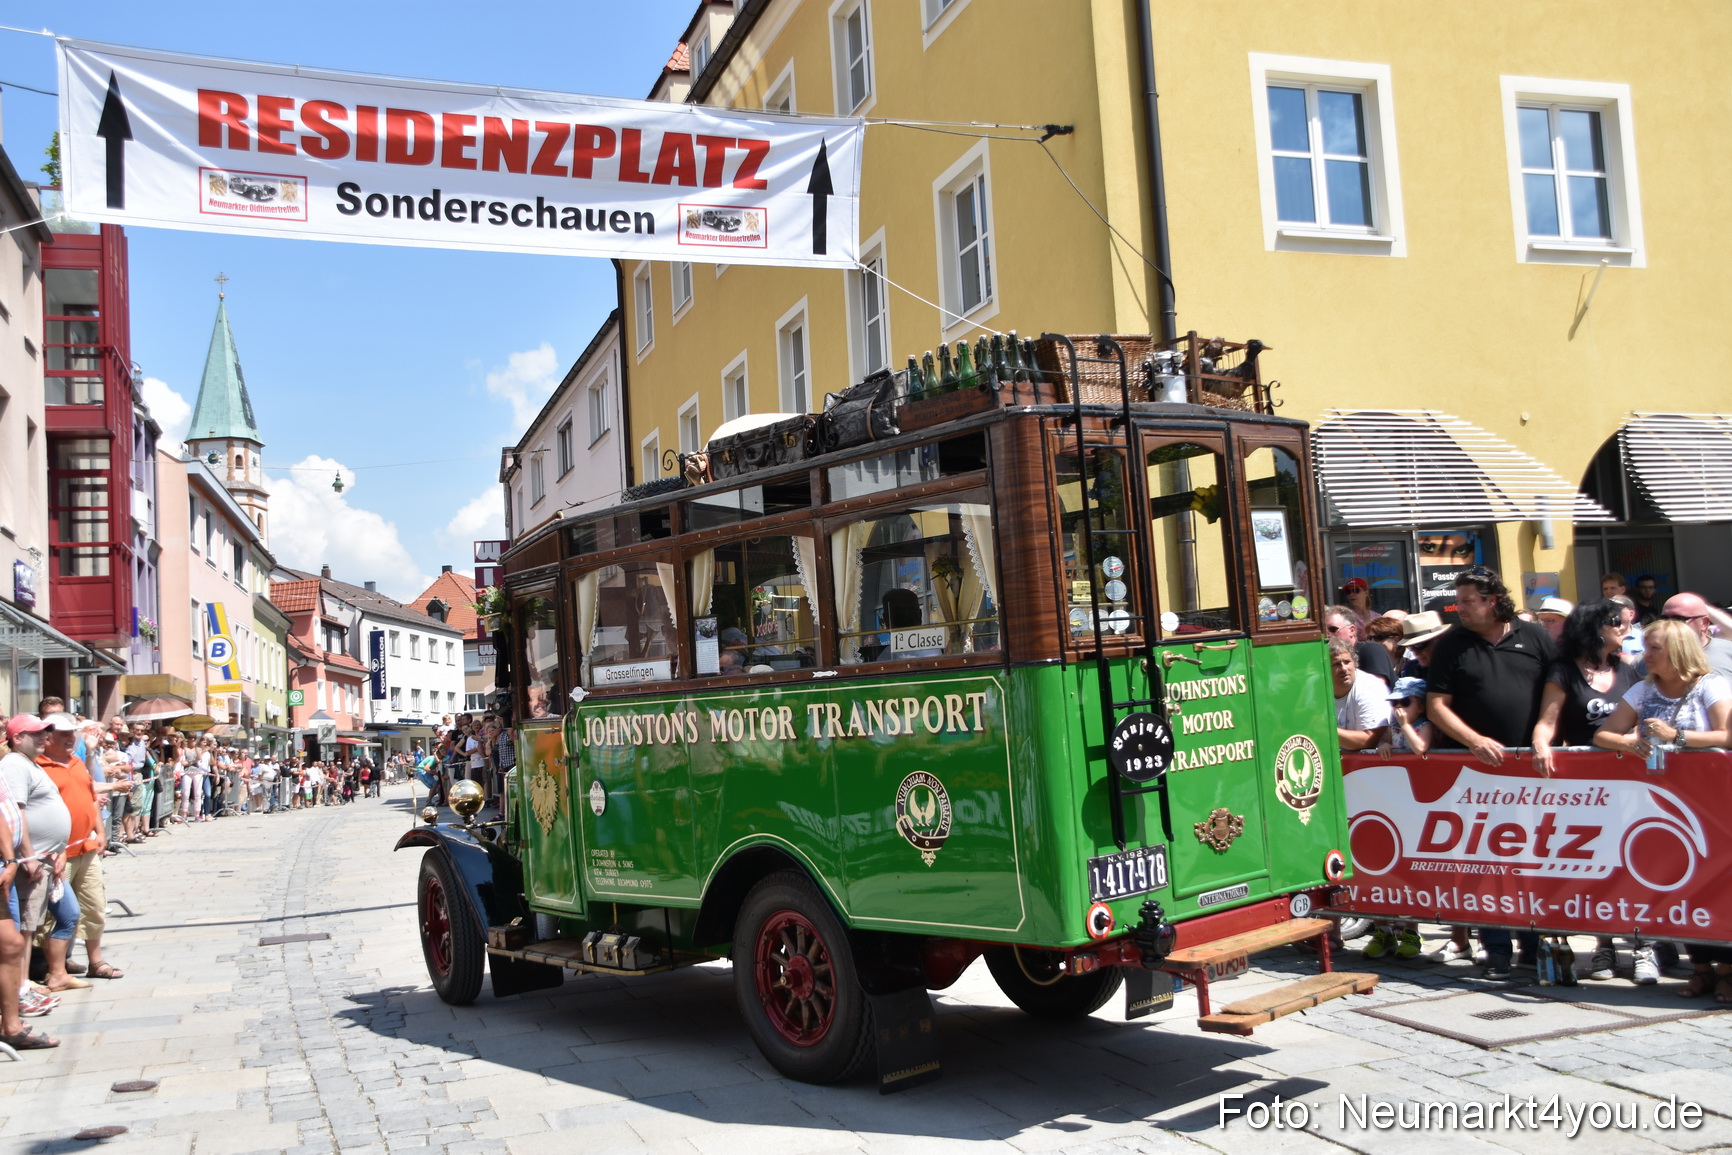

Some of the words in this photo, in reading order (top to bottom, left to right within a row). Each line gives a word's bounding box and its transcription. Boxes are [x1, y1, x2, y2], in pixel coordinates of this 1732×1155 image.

[198, 88, 770, 190] RESIDENZPLATZ
[209, 198, 248, 212] Neumarkter
[249, 204, 301, 214] Oldtimertreffen
[336, 181, 655, 235] Sonderschauen
[685, 230, 718, 242] Neumarkter
[718, 234, 761, 243] Oldtimertreffen
[1422, 588, 1457, 597] Bewerbun
[908, 632, 943, 649] Classe
[606, 666, 655, 681] Grosselfingen
[1162, 674, 1247, 704] JOHNSTON'S
[583, 709, 699, 747] JOHNSTON'S
[709, 705, 797, 742] MOTOR
[806, 692, 987, 739] TRANSPORT
[1182, 709, 1235, 735] MOTOR
[1113, 718, 1170, 751] Baujahr
[1125, 754, 1163, 772] 1923
[1170, 739, 1254, 772] TRANSPORT
[1456, 786, 1611, 807] Autoklassik
[1416, 810, 1603, 861] Dietz
[1410, 860, 1509, 876] BREITENBRUNN
[1200, 886, 1247, 906] INTERNATIONAL
[1294, 897, 1309, 914] GB
[1303, 884, 1711, 928] w.autoklassik-dietz.de
